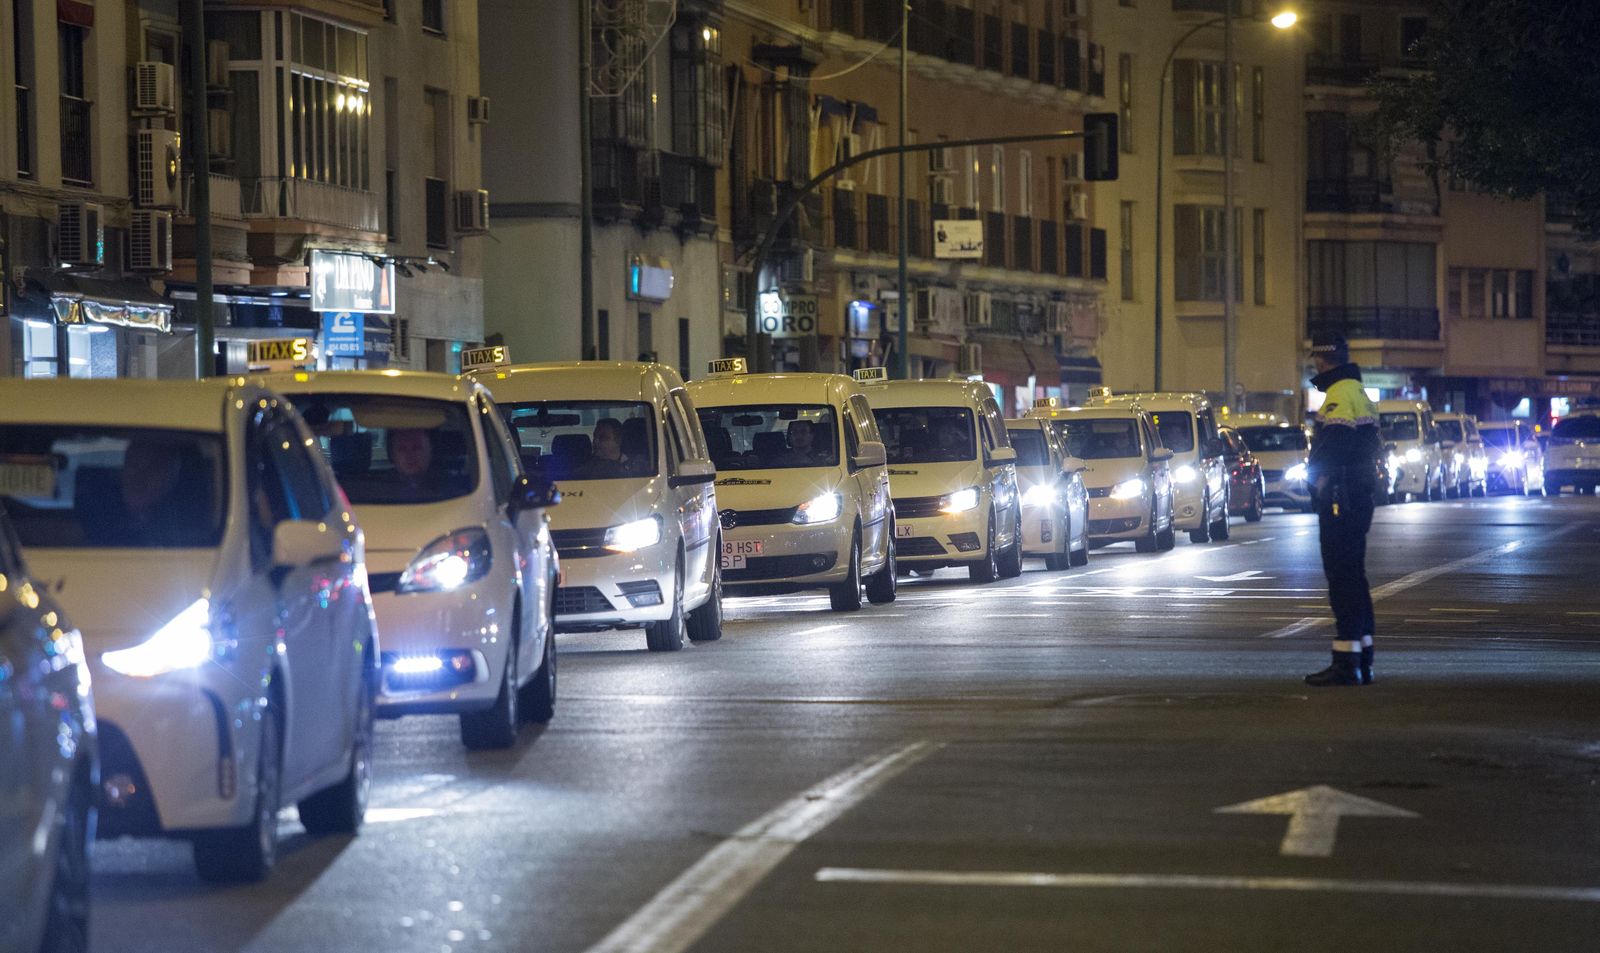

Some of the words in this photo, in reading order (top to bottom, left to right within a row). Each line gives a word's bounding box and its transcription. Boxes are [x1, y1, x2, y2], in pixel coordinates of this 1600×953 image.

[763, 300, 816, 314] COMPRO
[763, 316, 815, 332] ORO
[860, 369, 877, 379] TAXI
[897, 526, 911, 537] LX
[737, 541, 761, 553] HST
